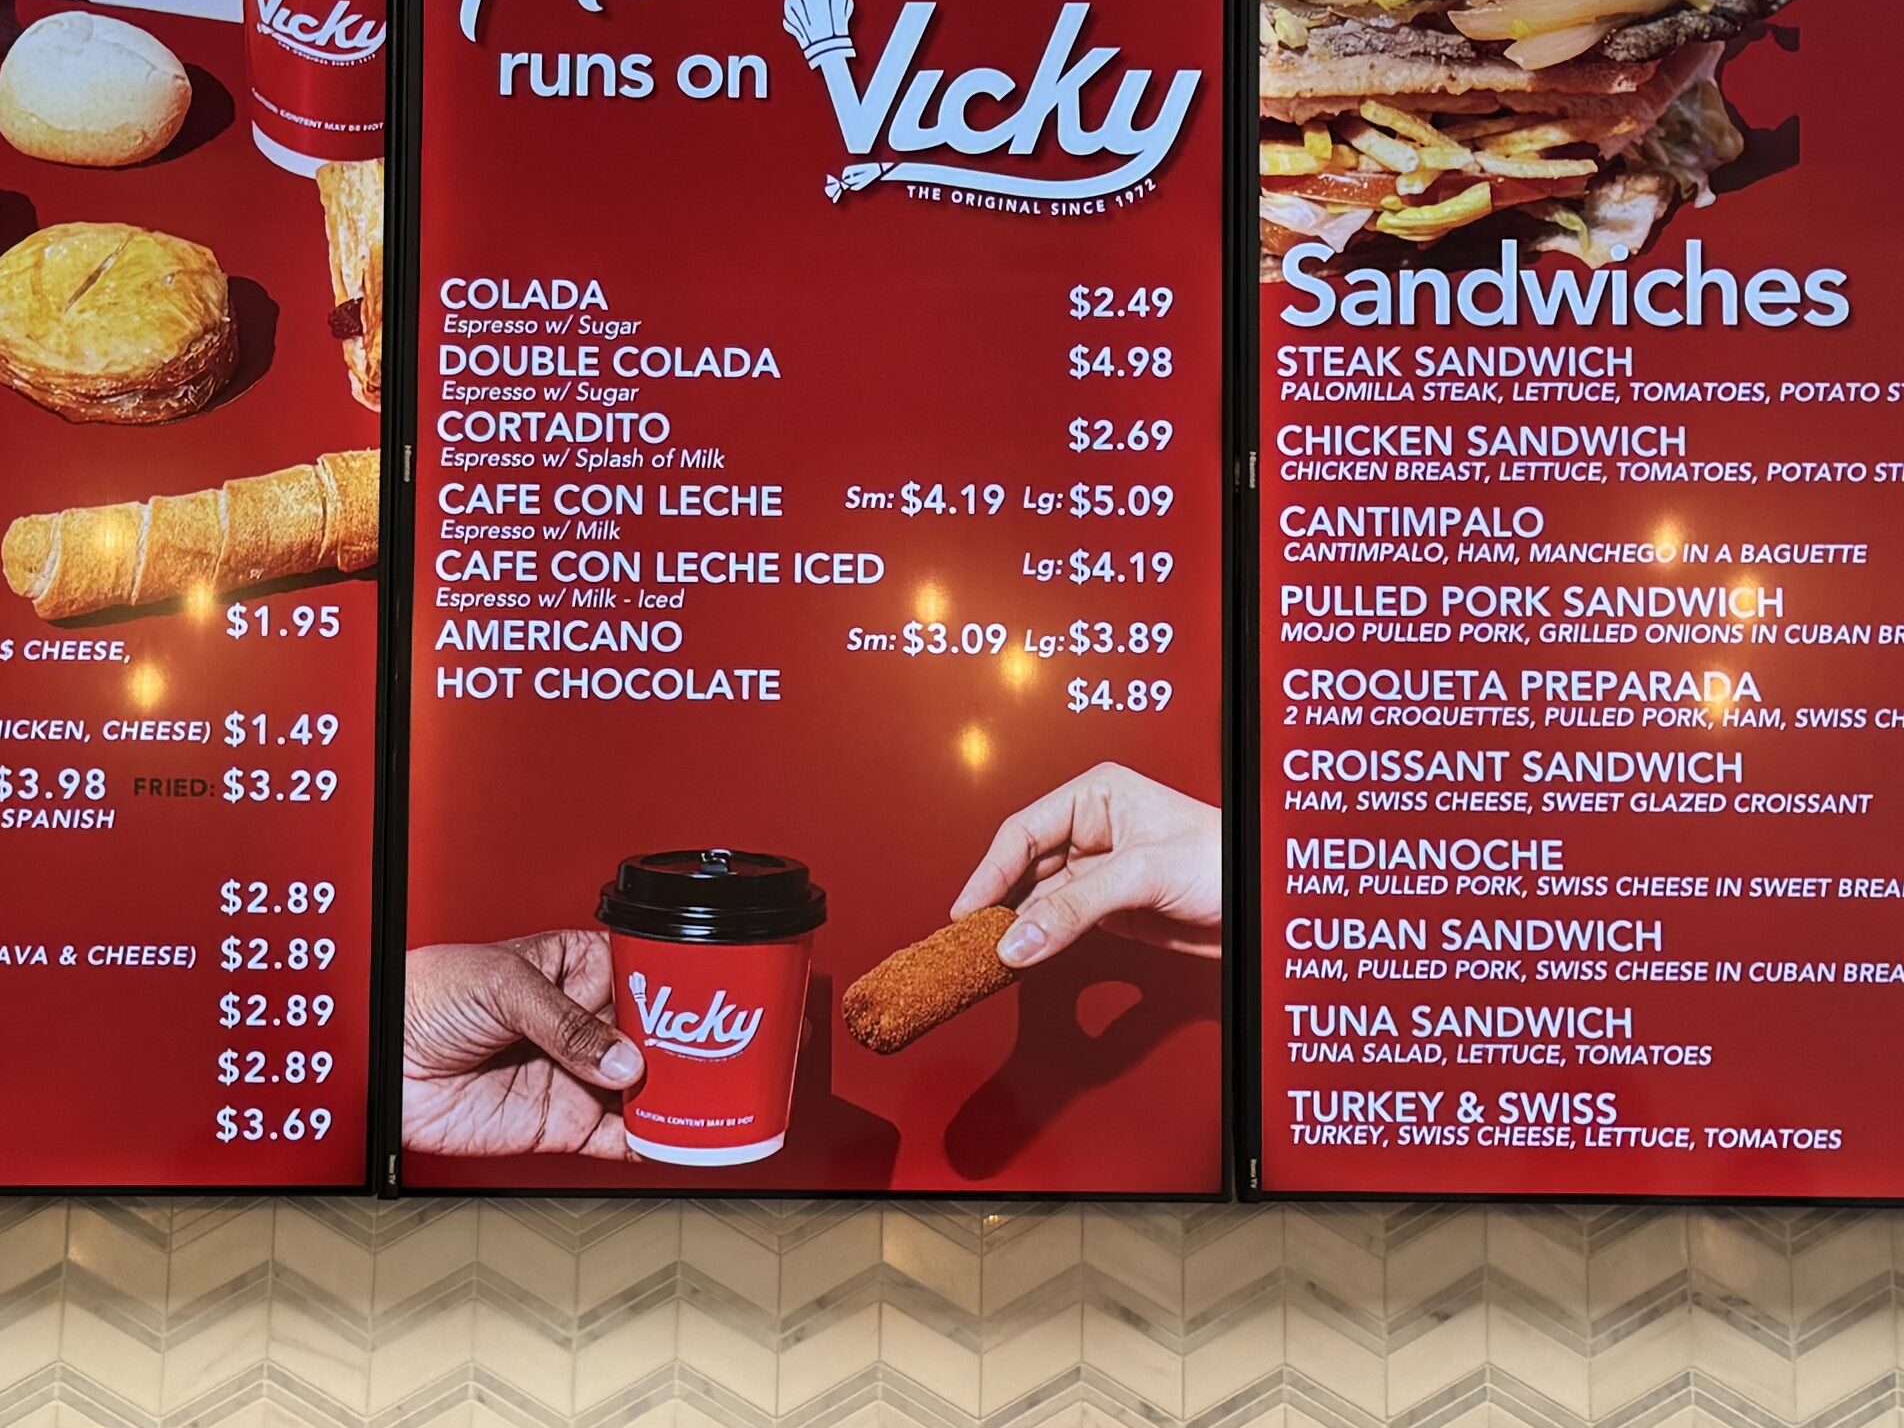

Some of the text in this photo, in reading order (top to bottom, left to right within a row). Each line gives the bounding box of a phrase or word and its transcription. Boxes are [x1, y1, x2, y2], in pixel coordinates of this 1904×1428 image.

[500, 53, 767, 98] runs on
[907, 178, 1157, 216] THE ORIGINAL SINCE 1972
[441, 278, 1173, 320] COLADA $2.49
[1281, 239, 1849, 326] Sandwiches
[440, 344, 1172, 379] DOUBLE COLADA $4.98
[1277, 346, 1402, 377] STEAK
[1415, 346, 1632, 377] SANDWICH
[437, 411, 1172, 453] CORTADITO $2.69
[441, 447, 725, 472] Espresso w/ Splash of Milk
[1280, 506, 1543, 538] CANTIMPALO
[227, 602, 339, 639] $1.95
[435, 620, 1173, 658] AMERICANO Sm: $3.09 Lg: $3.89
[437, 667, 1172, 713] HOT CHOCOLATE $4.89
[1283, 669, 1507, 700] CROQUETA
[1522, 670, 1761, 703] PREPARADA
[103, 721, 210, 743] CHEESE)
[224, 711, 338, 747] $1.49
[133, 777, 216, 797] FRIED:
[223, 767, 337, 803] $3.29
[1287, 839, 1563, 871] MEDIANOCHE
[221, 879, 334, 916] $2.89
[1286, 918, 1426, 950] CUBAN
[1442, 919, 1661, 952] SANDWICH
[220, 992, 334, 1029] $2.89
[218, 1049, 332, 1086] $2.89
[1288, 1043, 1712, 1067] TUNA SALAD, LETTUCE, TOMATOES
[216, 1106, 331, 1143] $3.69
[1288, 1091, 1444, 1122] TURKEY
[1457, 1091, 1484, 1123] &
[1499, 1092, 1616, 1124] SWISS
